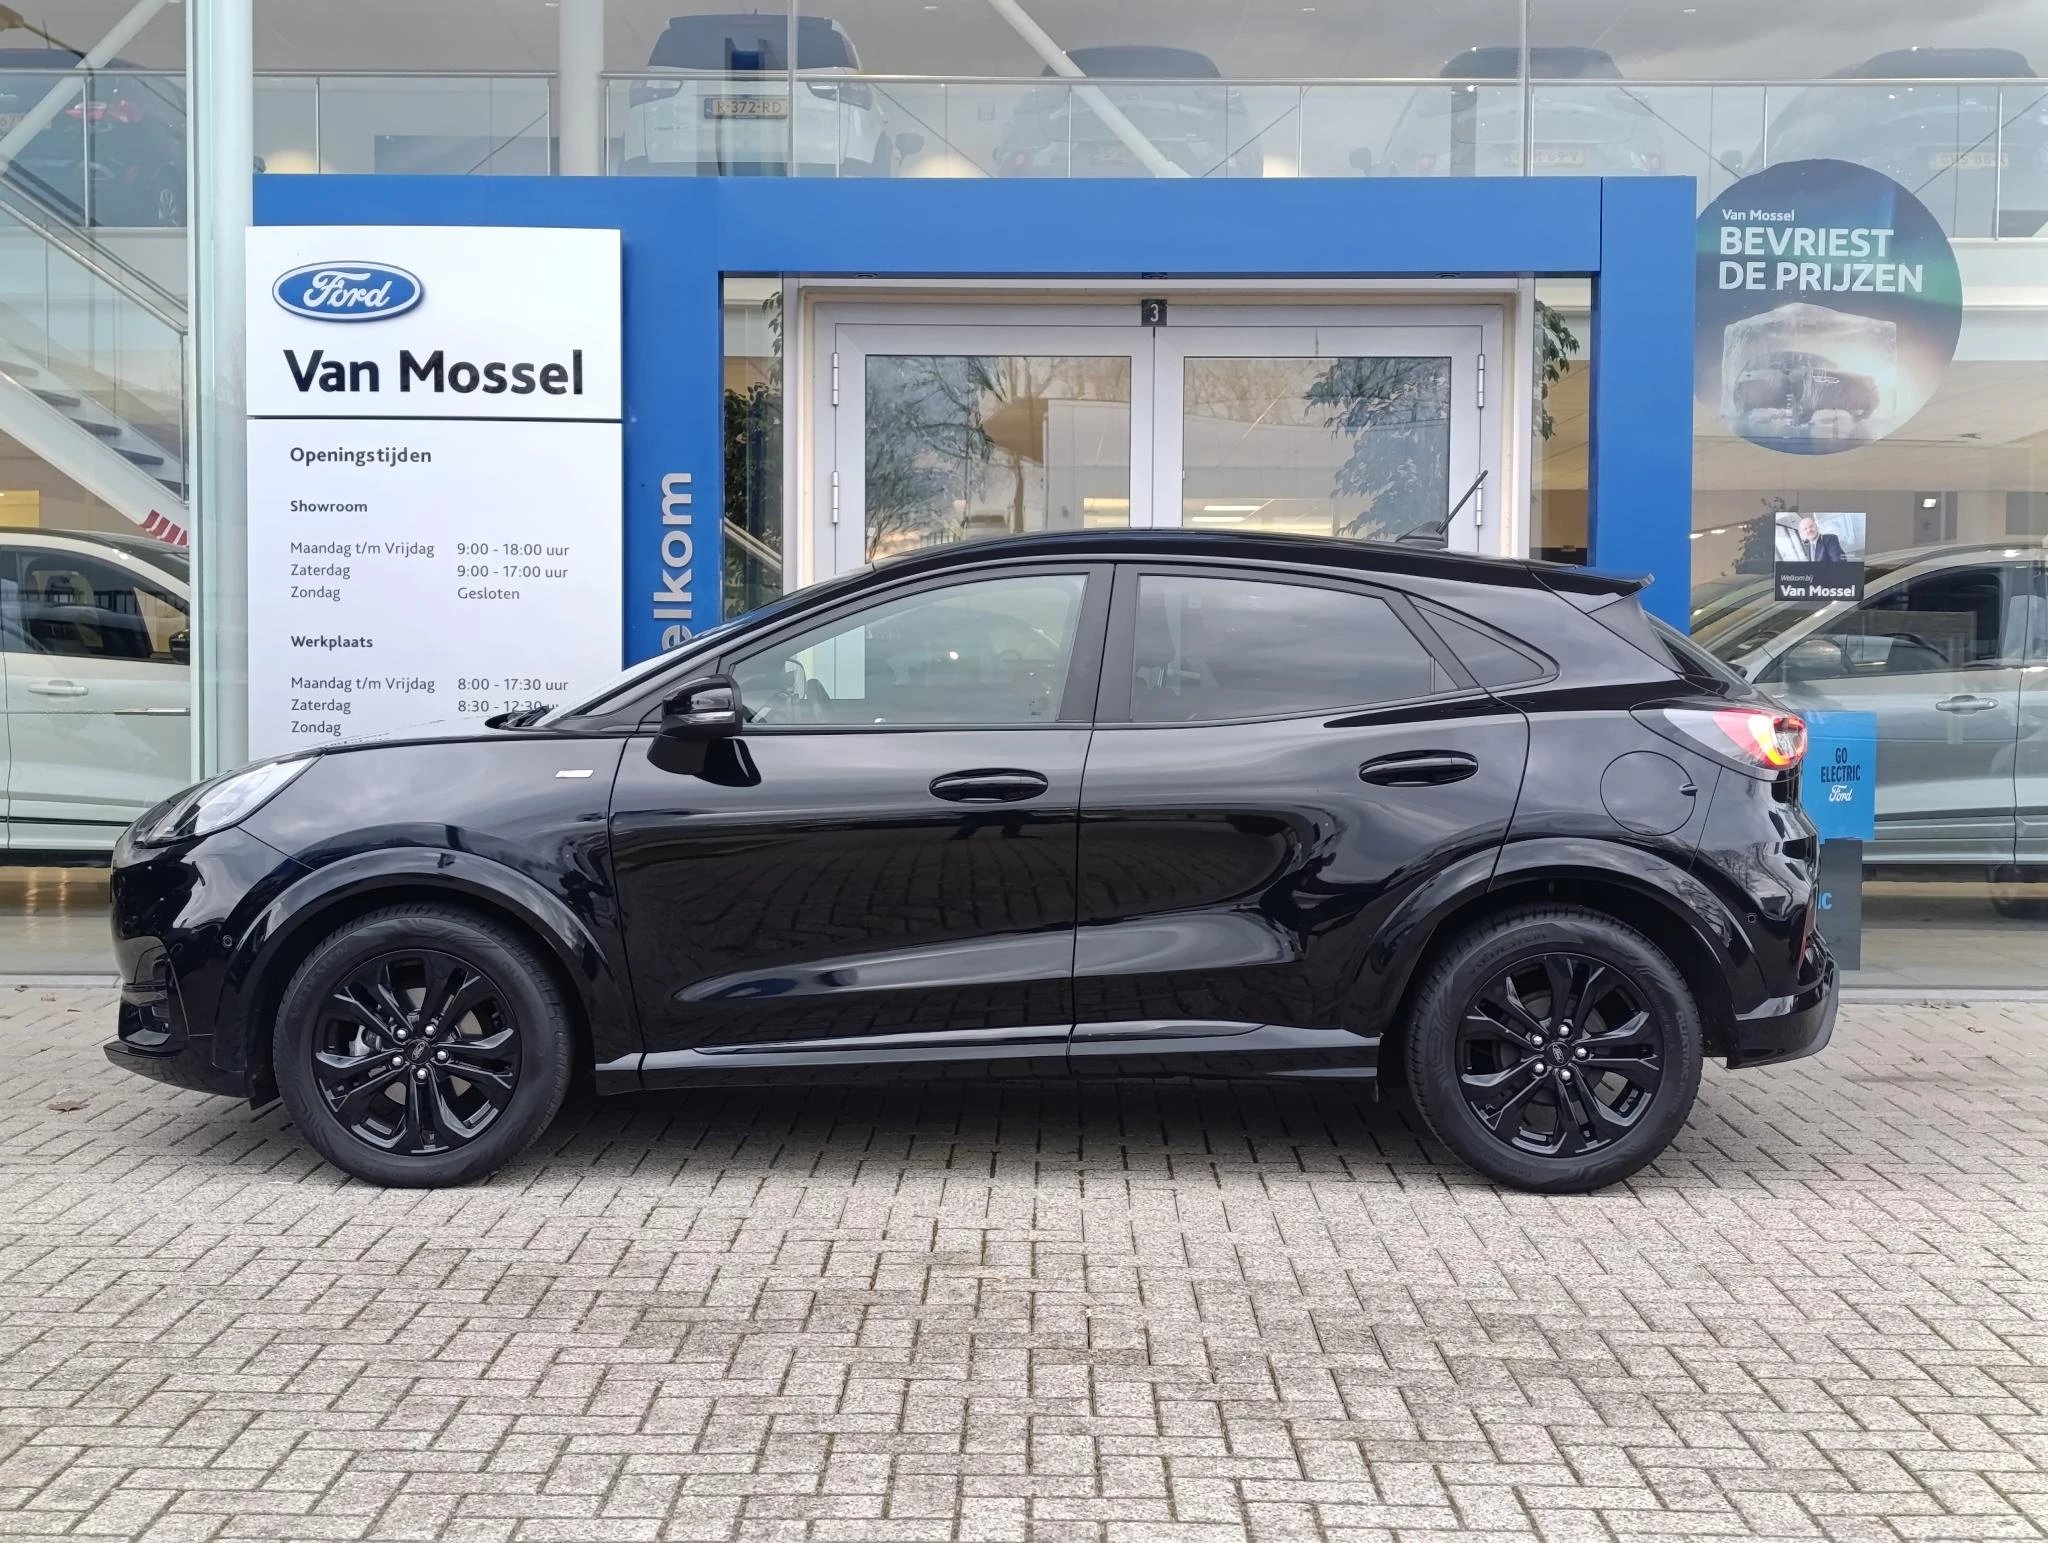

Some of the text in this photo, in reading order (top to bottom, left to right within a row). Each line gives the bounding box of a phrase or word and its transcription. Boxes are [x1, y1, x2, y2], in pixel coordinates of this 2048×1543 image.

[1722, 209, 1795, 221] Van Mossel
[1720, 227, 1894, 257] BEVRIEST
[1718, 261, 1923, 293] DE PRIJZEN
[303, 270, 392, 308] Ford
[1150, 303, 1159, 322] 3
[283, 349, 583, 395] Van Mossel
[290, 447, 432, 466] Openingstijden
[290, 500, 368, 513] Showroom
[290, 542, 352, 557] Maandag
[355, 542, 381, 555] t/m
[385, 542, 435, 558] Vrijdag
[457, 543, 489, 555] 9:00
[502, 544, 542, 556] 18:00
[546, 546, 570, 556] uur
[653, 472, 693, 651] elkom
[290, 564, 351, 579] Zaterdag
[457, 565, 489, 577] 9:00
[503, 566, 541, 578] 17:00
[545, 568, 569, 578] uur
[290, 586, 520, 601] Zondag Gesloten
[1780, 585, 1856, 597] Van Mossel
[290, 635, 373, 651] Werkplaats
[291, 677, 352, 692] Maandag
[355, 677, 381, 690] t/m
[385, 677, 435, 693] Vrijdag
[457, 678, 490, 690] 8:00
[503, 678, 541, 691] 17:30
[545, 681, 569, 691] uur
[291, 699, 351, 714] Zaterdag
[457, 700, 490, 712] 8:30
[291, 721, 341, 736] Zondag
[1835, 747, 1848, 764] GO
[1820, 764, 1861, 783] ELECTRIC
[1829, 784, 1853, 802] Ford
